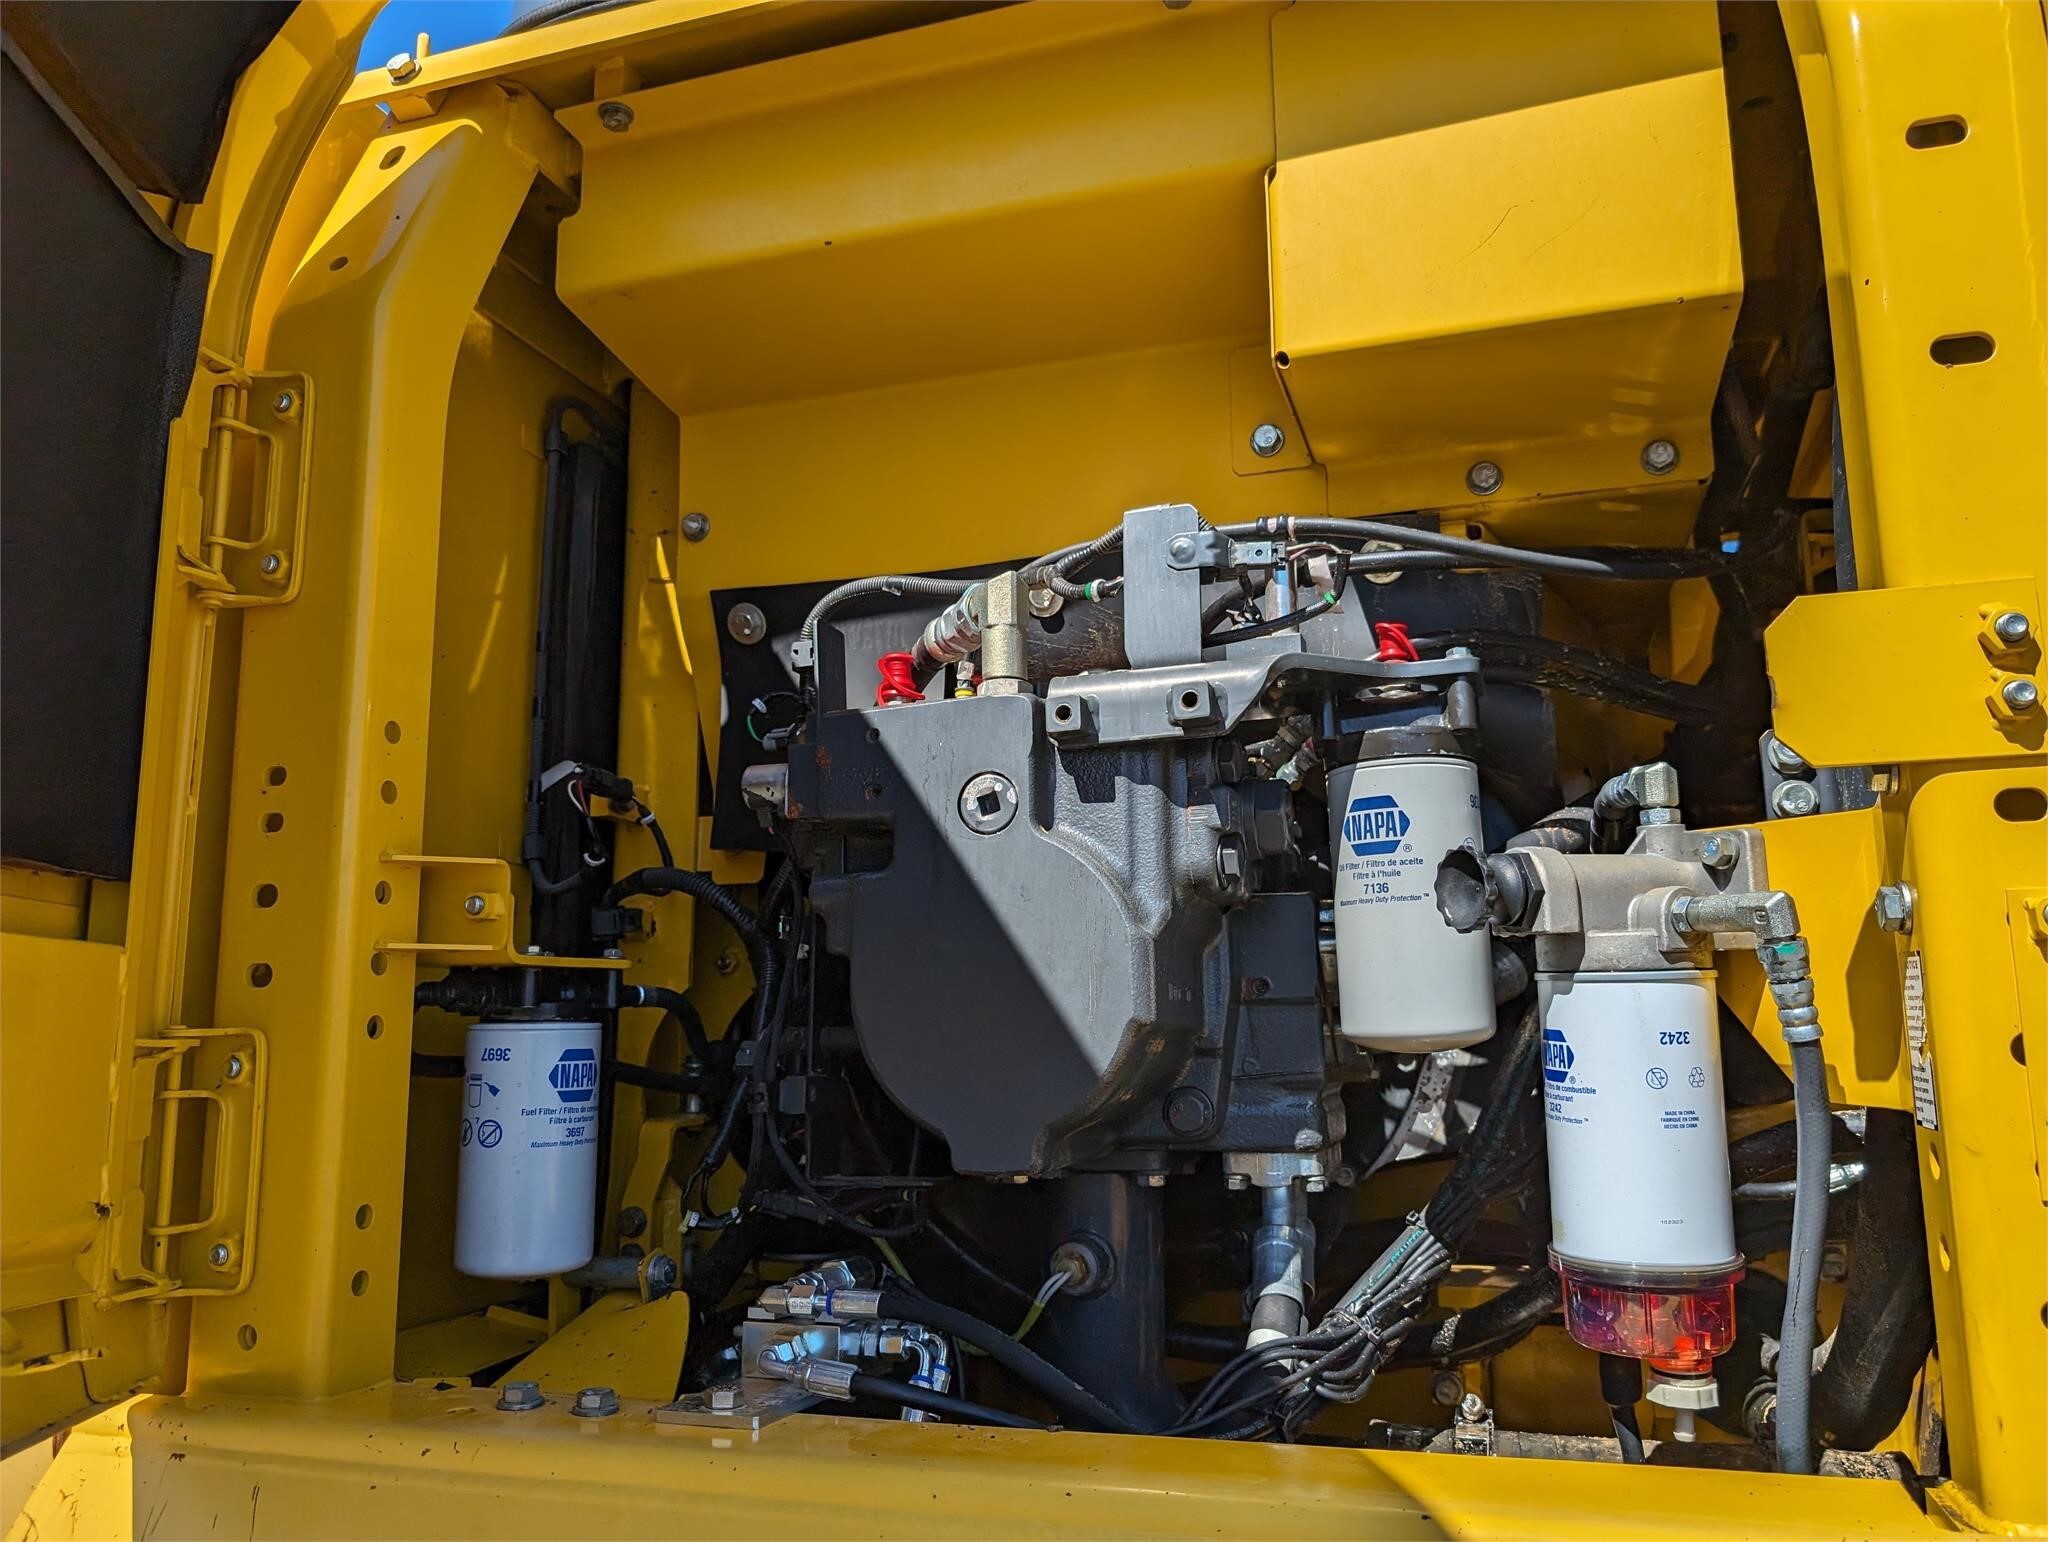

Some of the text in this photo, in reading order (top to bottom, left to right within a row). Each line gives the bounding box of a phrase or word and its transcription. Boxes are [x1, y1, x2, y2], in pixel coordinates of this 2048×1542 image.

[1351, 810, 1398, 842] NAPA
[1346, 862, 1360, 870] Filter
[1366, 860, 1385, 868] Filtro
[1387, 859, 1397, 867] de
[1400, 857, 1424, 866] aceite
[1353, 872, 1369, 880] Filtre
[1377, 869, 1401, 878] l'huile
[1363, 882, 1389, 894] 7136
[1659, 1031, 1690, 1045] 3242
[481, 1047, 511, 1061] 3697
[560, 1063, 593, 1088] NAPA
[1562, 1086, 1596, 1094] combustible
[521, 1108, 537, 1116] Fuel
[566, 1127, 585, 1137] 3697
